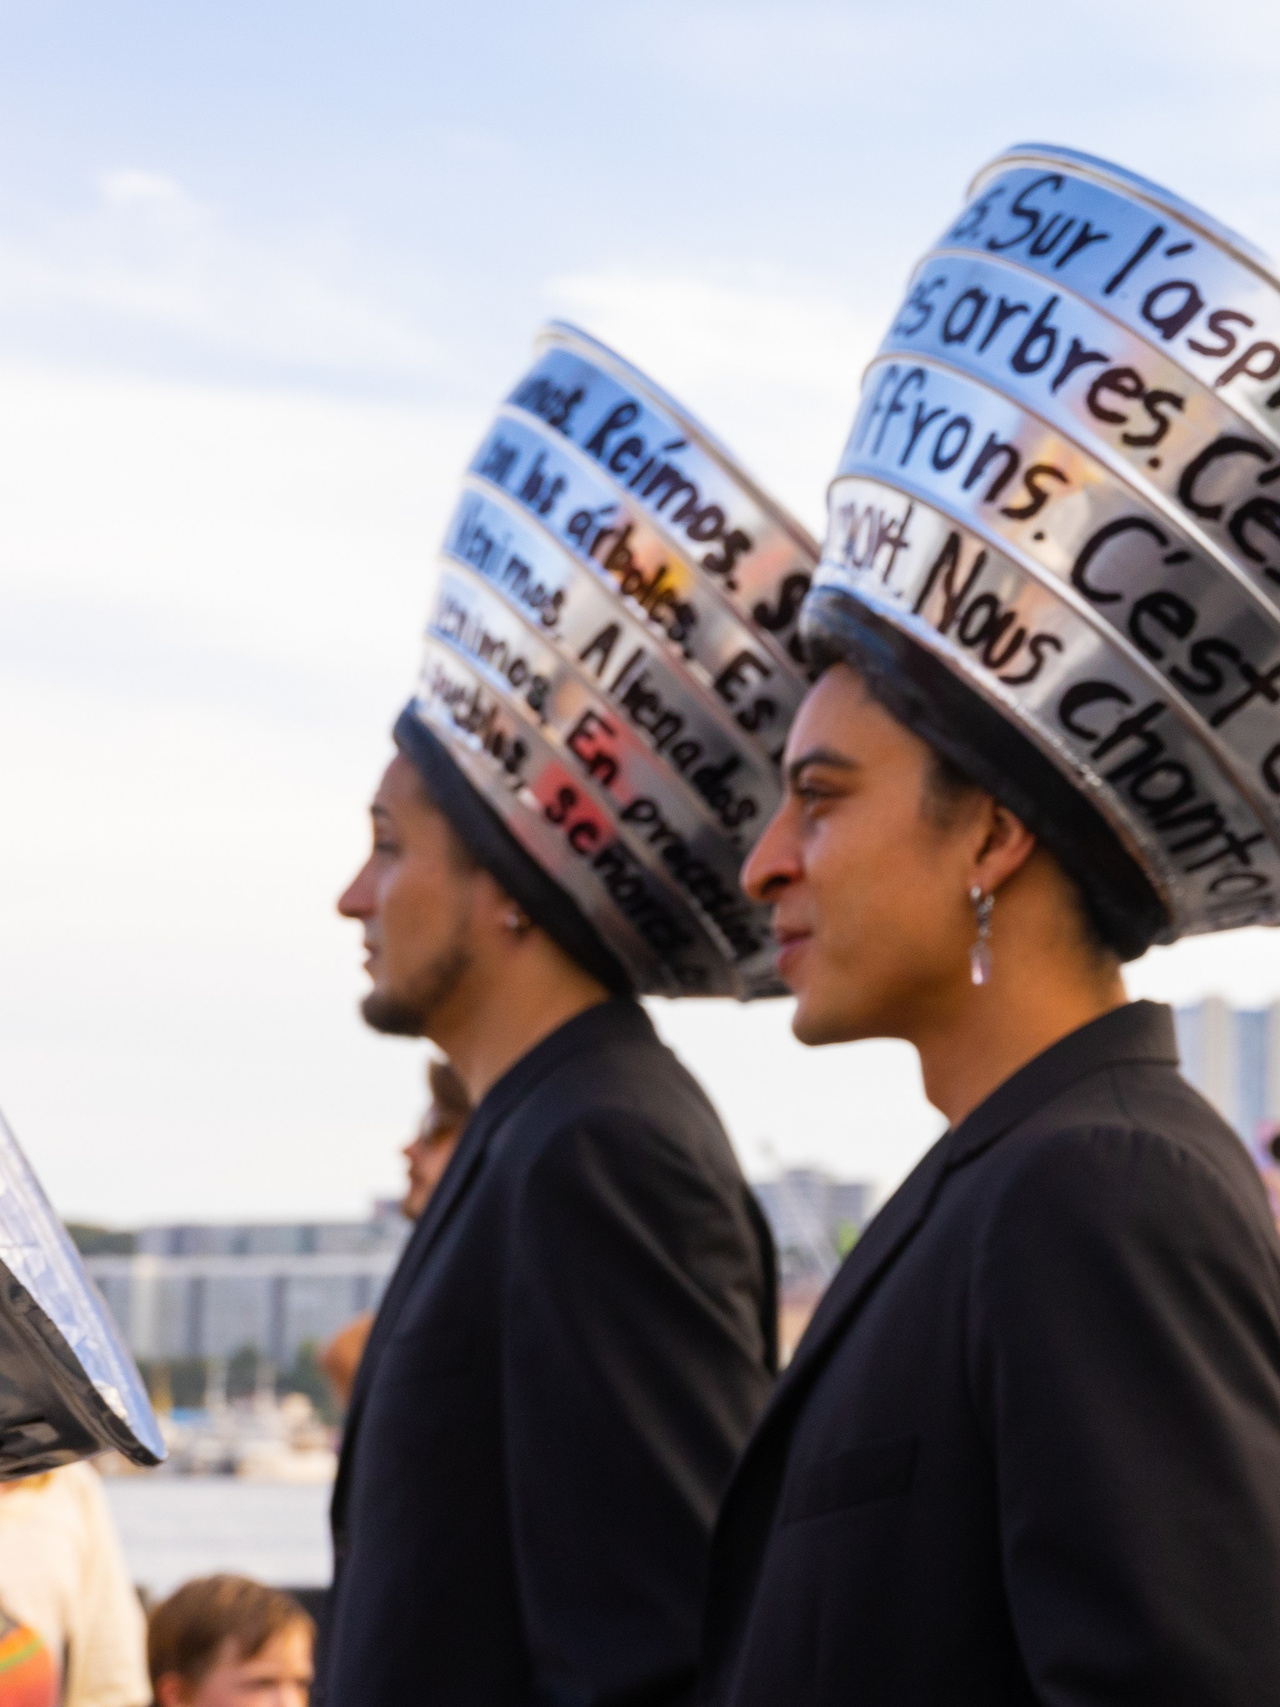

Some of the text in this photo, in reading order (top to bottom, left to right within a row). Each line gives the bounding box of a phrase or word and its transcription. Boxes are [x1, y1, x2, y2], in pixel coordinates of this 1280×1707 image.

[986, 174, 1110, 269] Sur
[941, 285, 1185, 469] arbres.
[584, 400, 752, 592] Reímos.
[912, 530, 1063, 686] Nous
[567, 710, 618, 785] En
[715, 651, 776, 732] Es
